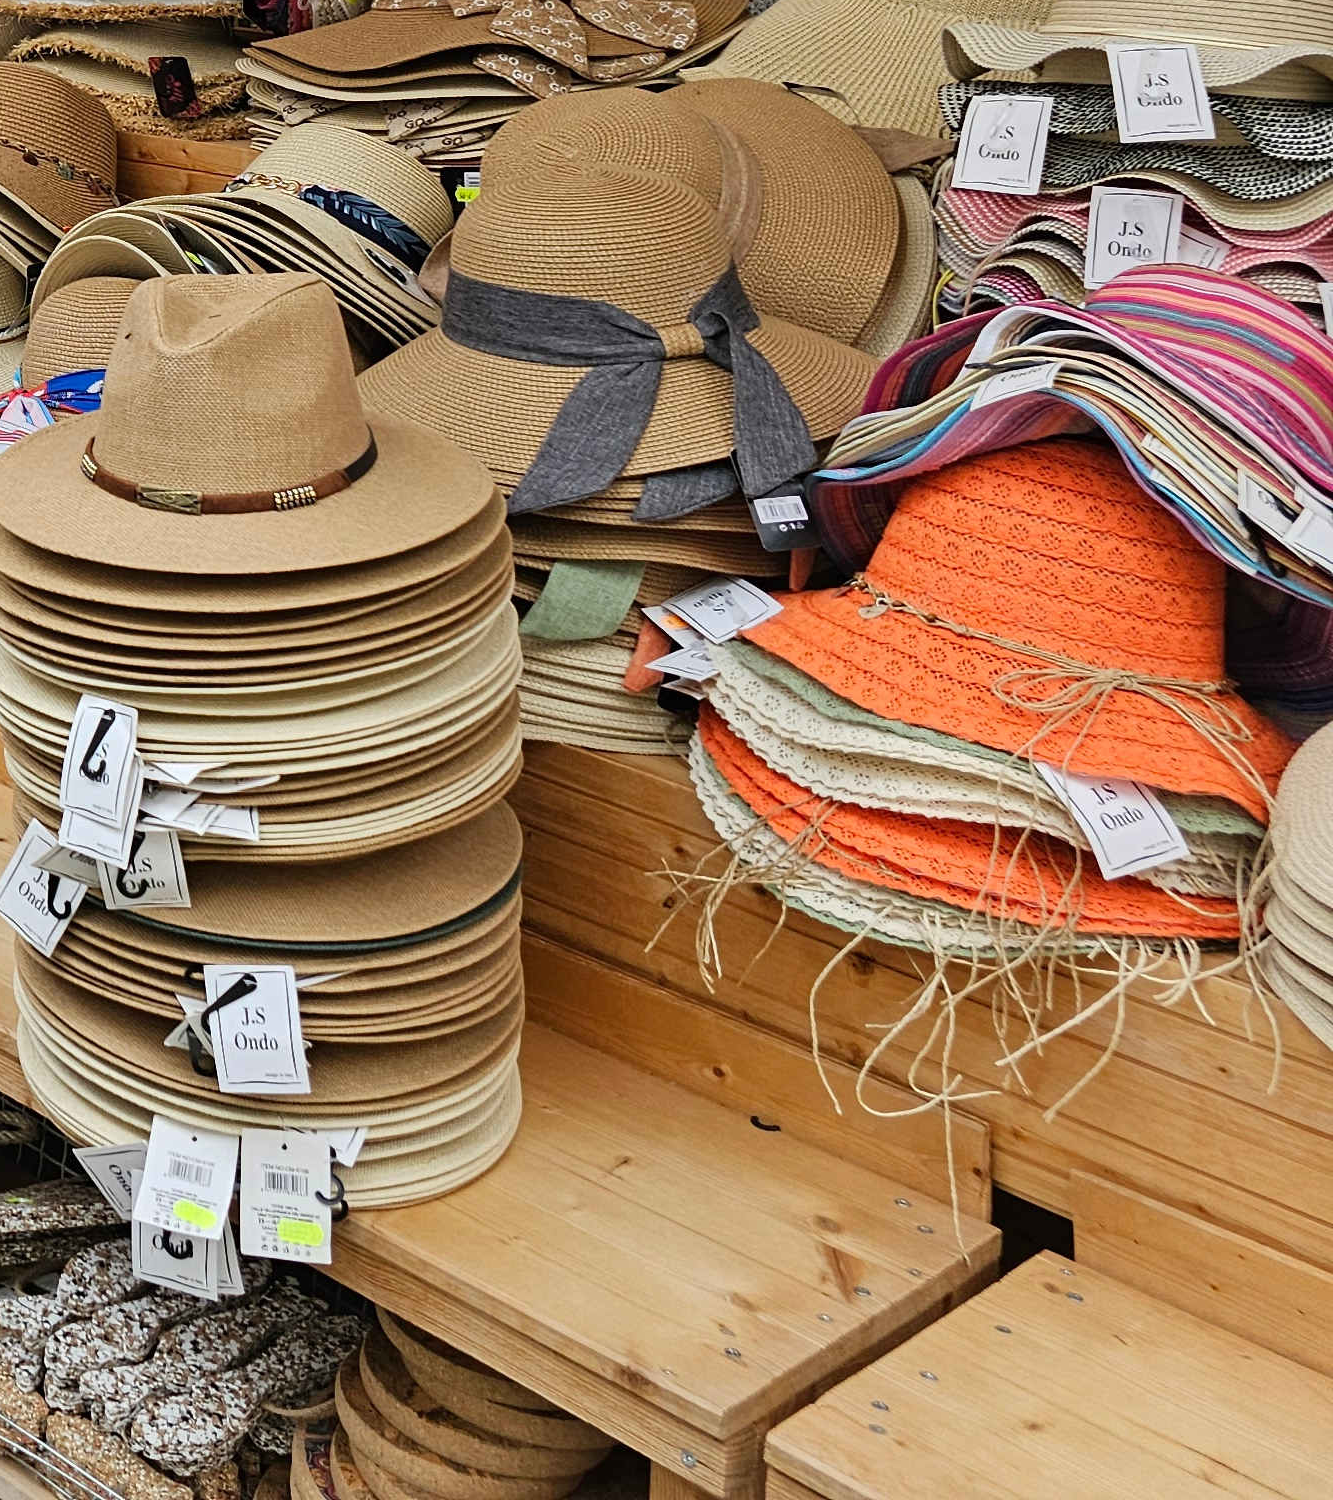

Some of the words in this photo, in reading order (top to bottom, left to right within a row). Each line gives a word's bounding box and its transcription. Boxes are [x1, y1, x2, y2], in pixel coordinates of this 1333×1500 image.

[1144, 72, 1169, 90] J.S
[1117, 220, 1144, 239] J.S
[1107, 241, 1152, 258] Ondo
[1091, 783, 1118, 805] J.S
[1100, 806, 1144, 830] Ondo
[18, 881, 50, 917] Ondo
[241, 1007, 266, 1025] J.S
[234, 1031, 279, 1052] Ondo
